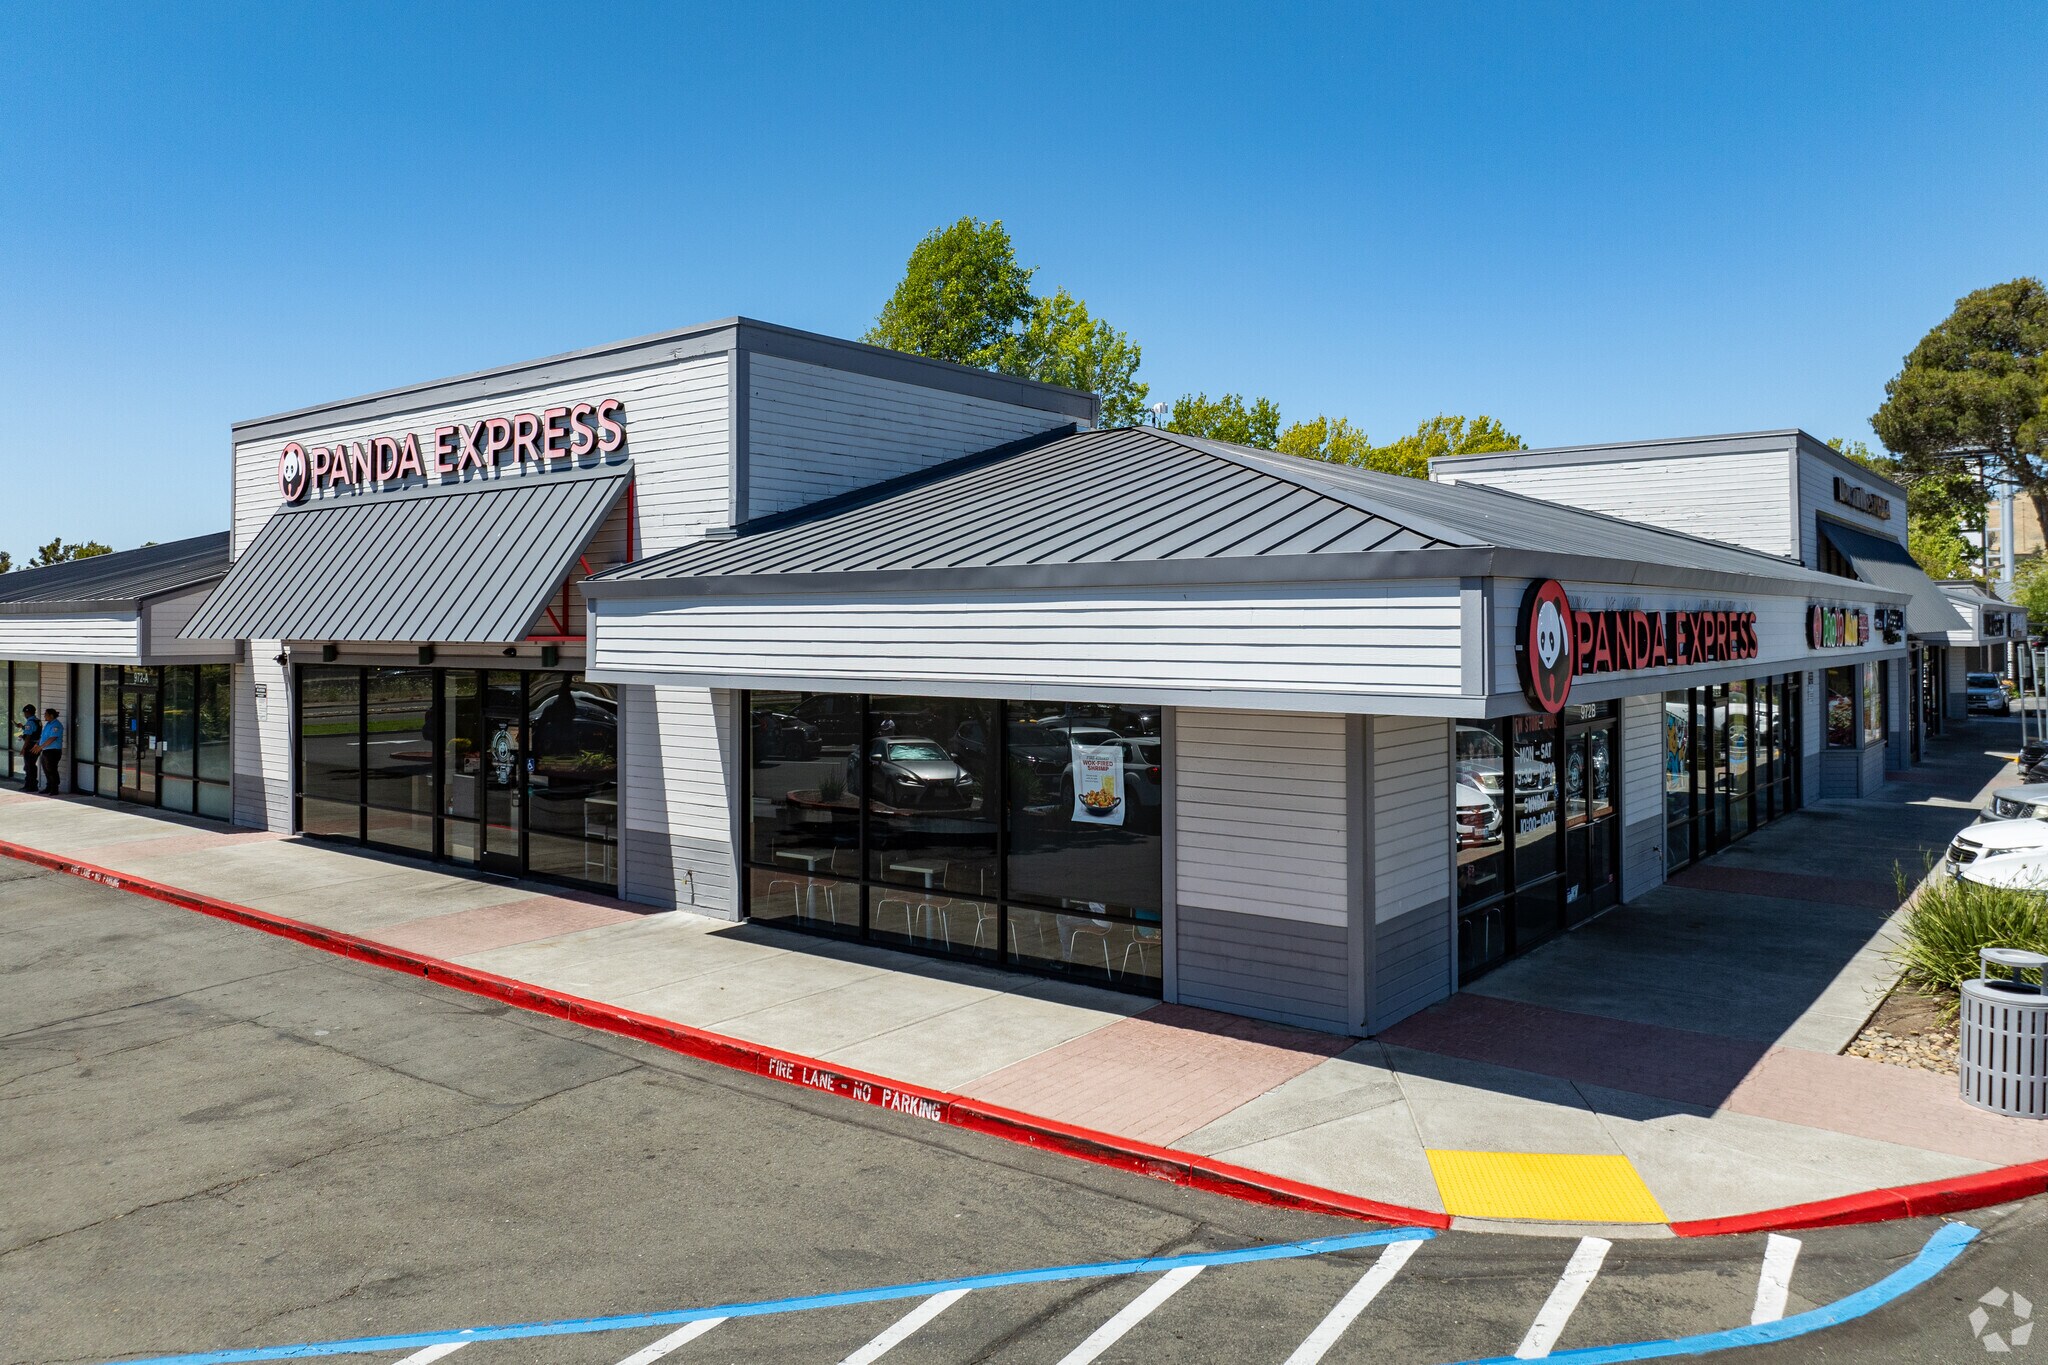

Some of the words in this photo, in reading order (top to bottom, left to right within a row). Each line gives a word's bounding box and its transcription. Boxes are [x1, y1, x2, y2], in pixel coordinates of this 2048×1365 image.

[313, 433, 426, 489] PANDA
[434, 399, 627, 474] EXPRESS
[1575, 610, 1668, 677] PANDA
[1676, 610, 1758, 666] EXPRESS
[133, 672, 149, 684] 972-A
[1580, 703, 1596, 719] 972B
[1520, 745, 1534, 763] MON
[1541, 742, 1552, 759] SAT
[1524, 792, 1549, 813] SUNDAY
[769, 1058, 795, 1080] FIRE
[802, 1067, 835, 1091] LANE
[853, 1081, 872, 1102] NO
[882, 1088, 941, 1122] PARKING
